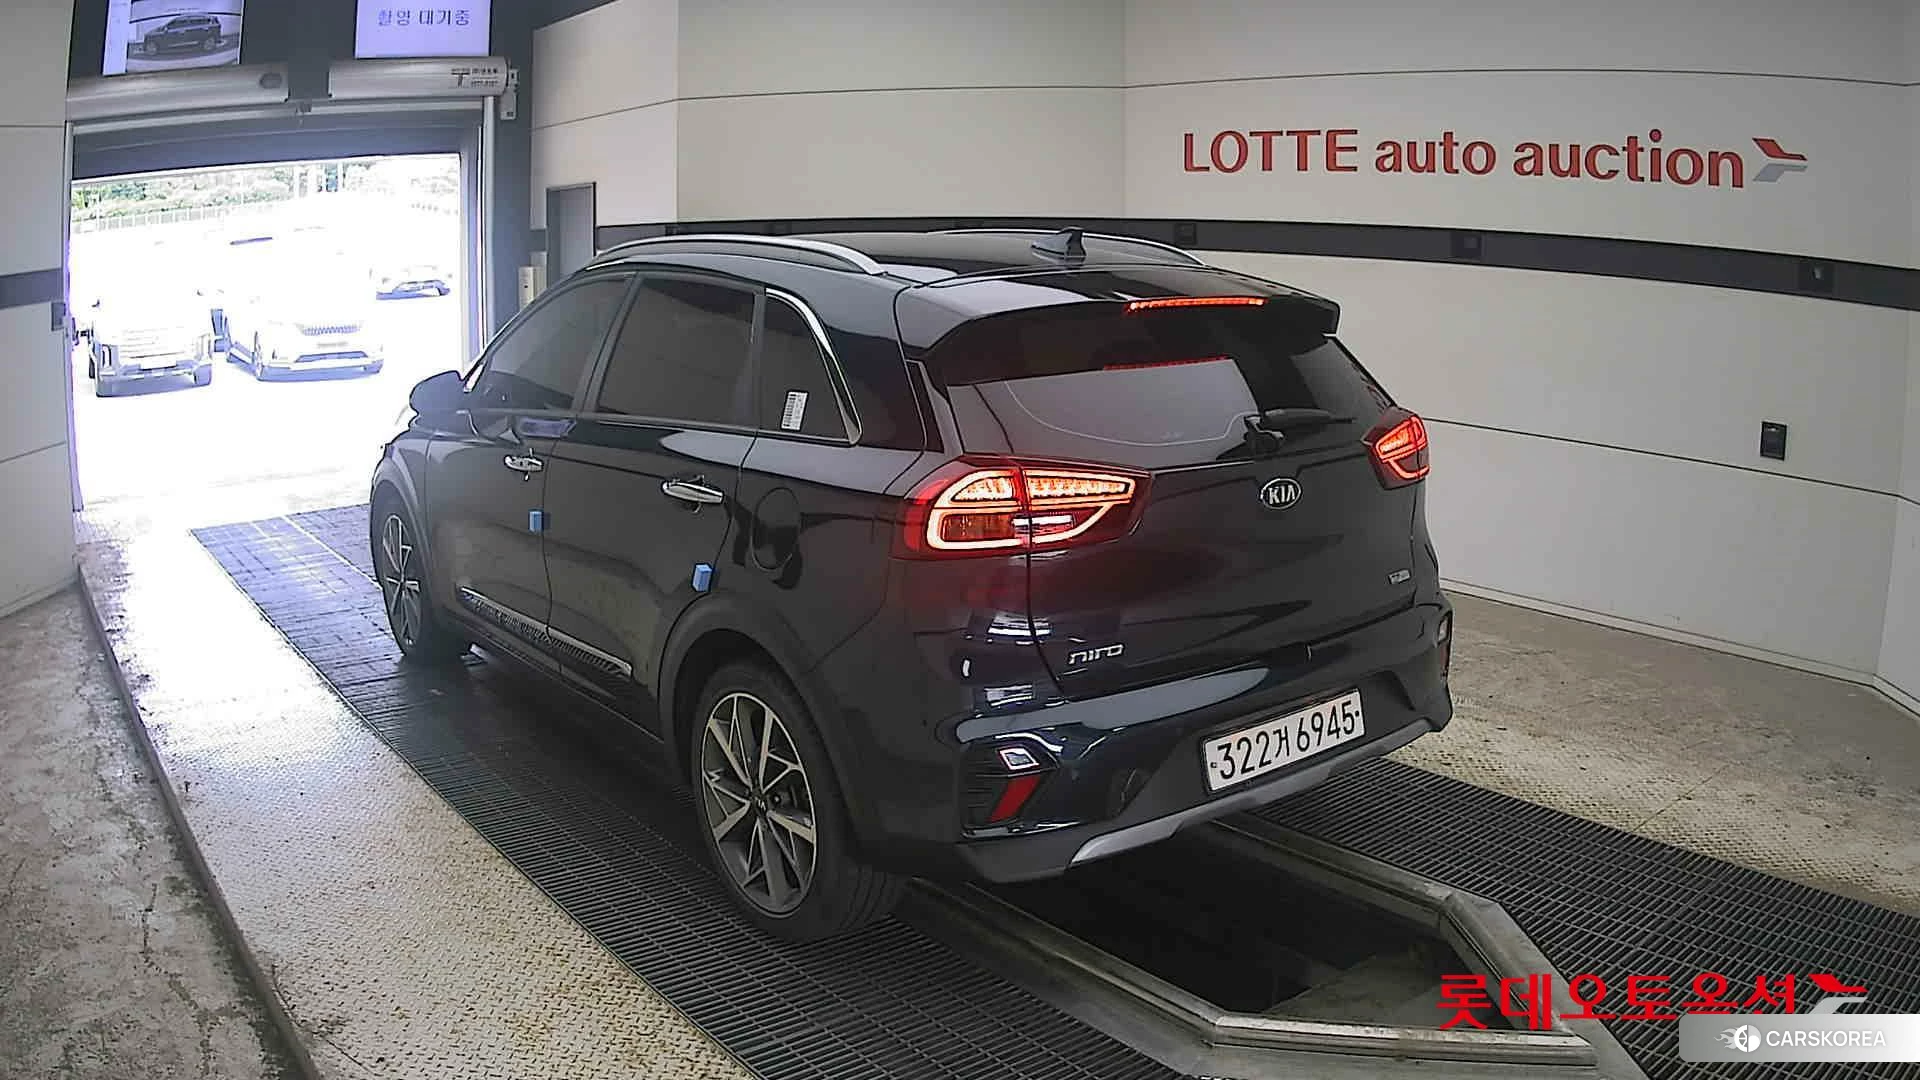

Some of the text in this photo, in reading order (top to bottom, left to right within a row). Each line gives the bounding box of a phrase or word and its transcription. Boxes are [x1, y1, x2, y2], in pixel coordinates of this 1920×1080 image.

[419, 9, 470, 26] 대기중
[1184, 129, 1744, 188] LOTTE auto auction
[1266, 483, 1297, 506] KIA
[1217, 700, 1355, 780] 322거 6945
